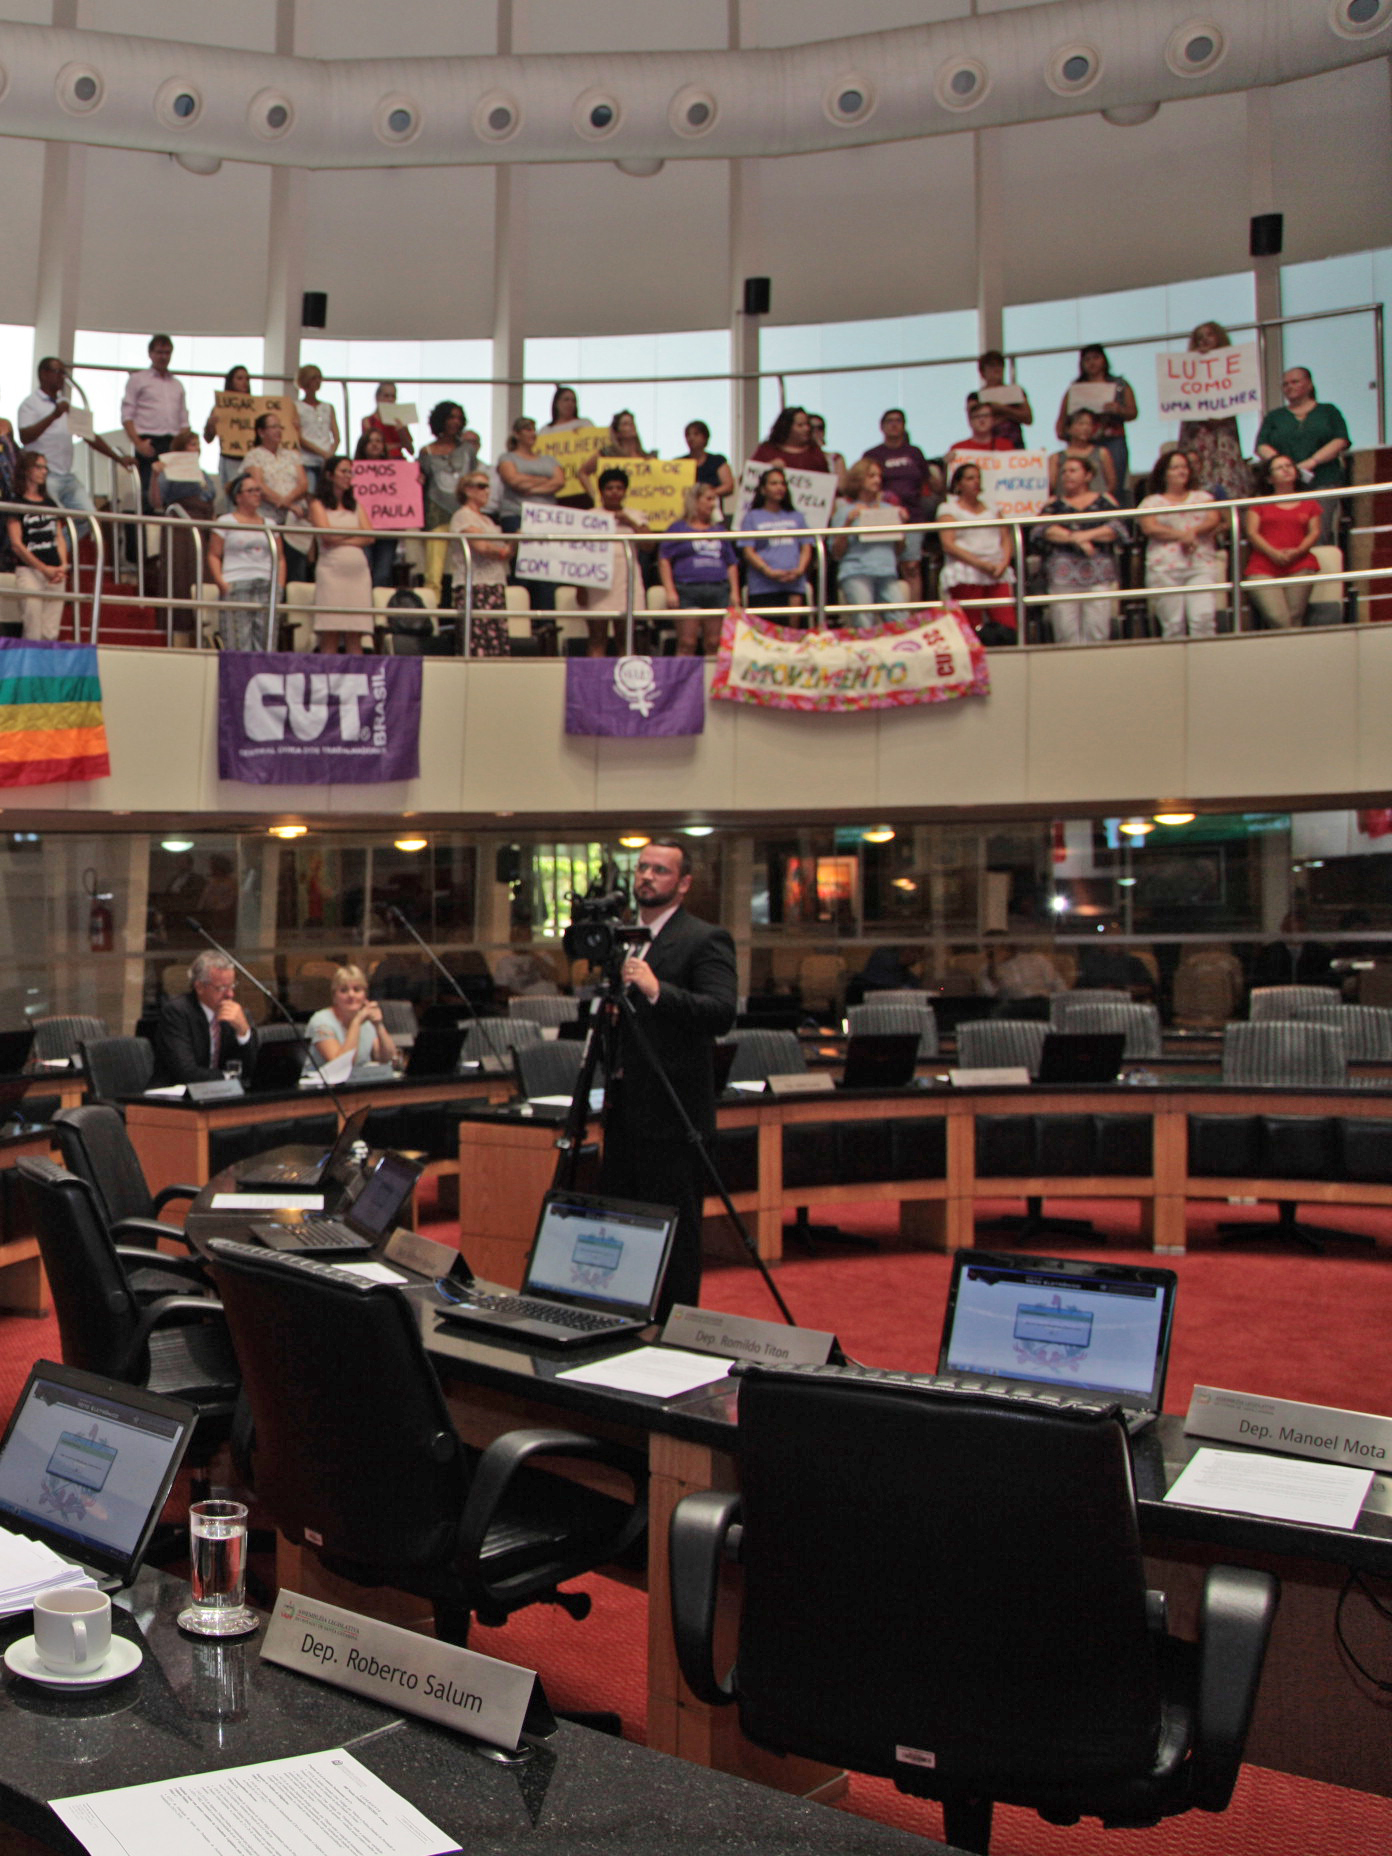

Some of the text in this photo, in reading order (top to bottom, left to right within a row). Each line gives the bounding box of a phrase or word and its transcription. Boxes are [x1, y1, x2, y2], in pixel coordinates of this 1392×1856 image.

[1167, 352, 1242, 380] LUTE
[1180, 377, 1232, 395] COMO
[1160, 389, 1257, 413] UMA MULHER
[354, 463, 397, 478] OMOS
[1009, 455, 1043, 470] COM
[371, 503, 416, 520] PAULA
[524, 508, 609, 530] MEXEU COM
[517, 558, 609, 583] COM TODAS
[740, 660, 908, 690] MOVIMENTO
[244, 673, 370, 742] CUT
[371, 664, 388, 747] BRASIL
[720, 1335, 762, 1354] Romildo
[764, 1343, 790, 1360] Titon
[1239, 1419, 1386, 1459] Dep. Manoel Mota
[301, 1633, 484, 1714] Dep. Roberto Salum
